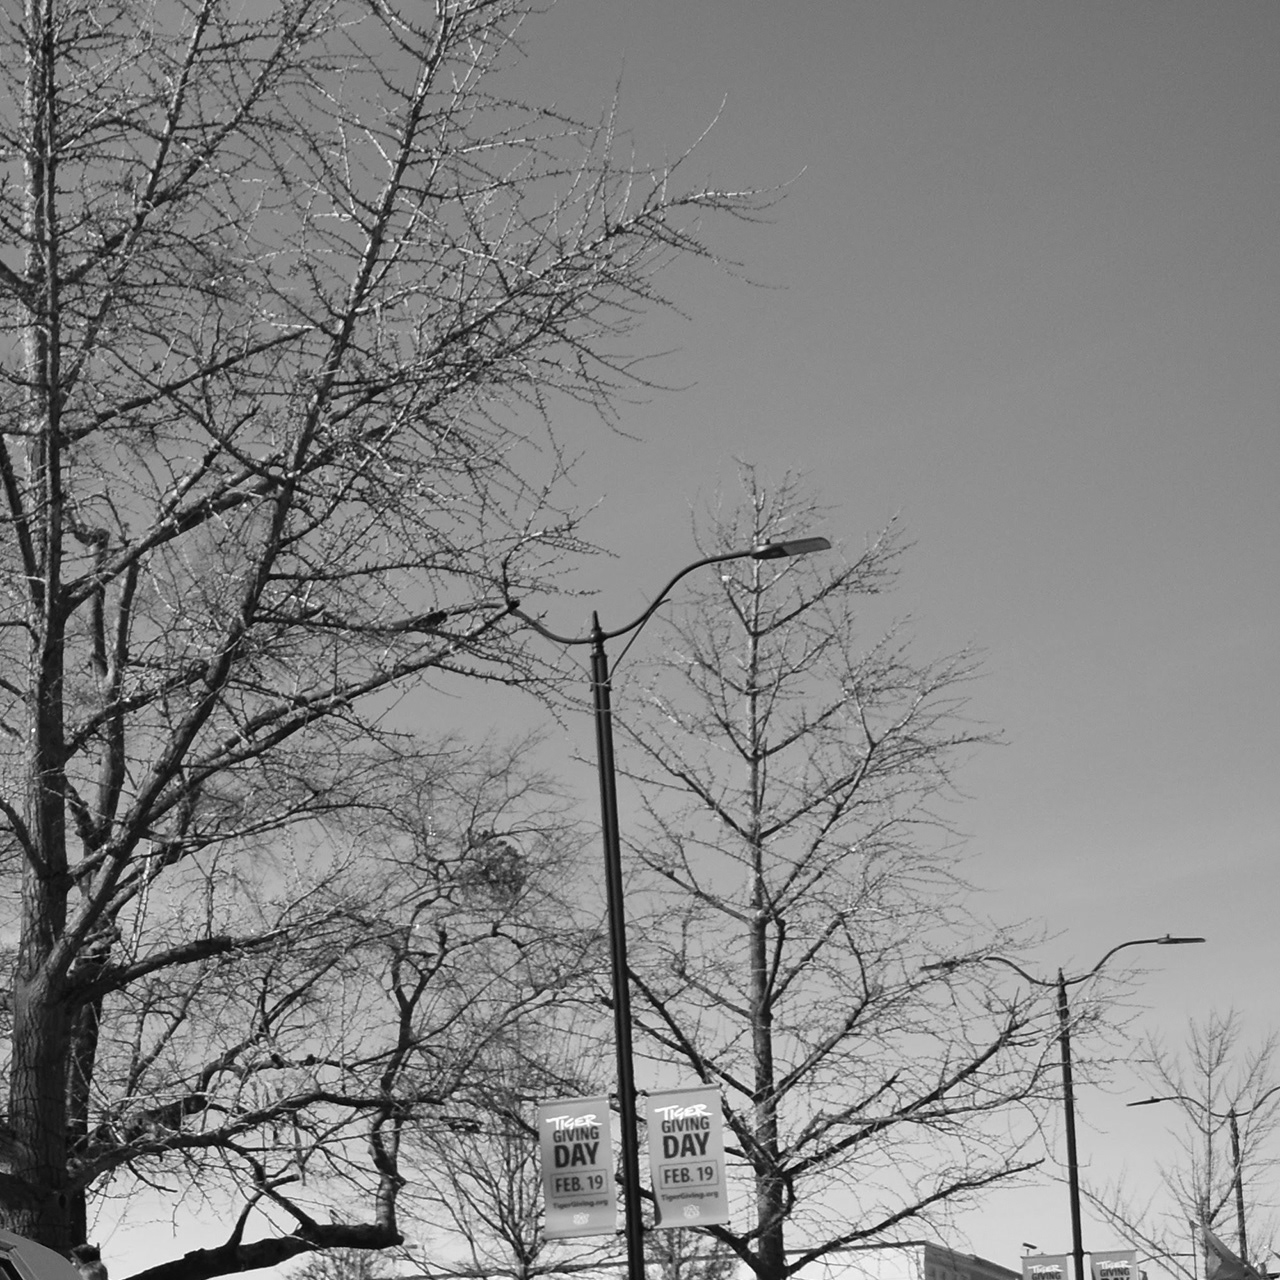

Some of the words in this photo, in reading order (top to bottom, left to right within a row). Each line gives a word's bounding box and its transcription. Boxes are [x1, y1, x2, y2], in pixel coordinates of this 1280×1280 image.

[654, 1103, 713, 1120] TIGER
[545, 1114, 603, 1130] TIGER
[661, 1116, 710, 1133] GIVING
[553, 1126, 599, 1143] GIVING
[663, 1132, 709, 1159] DAY
[554, 1141, 599, 1168] DAY
[664, 1167, 694, 1184] FEB.
[697, 1165, 713, 1181] 19
[555, 1177, 584, 1193] FEB.
[587, 1175, 603, 1190] 19
[661, 1190, 719, 1201] TigerGiving.org
[553, 1199, 609, 1210] TigerGiving.org
[1031, 1271, 1061, 1280] GIVING
[1099, 1267, 1130, 1277] GIVING
